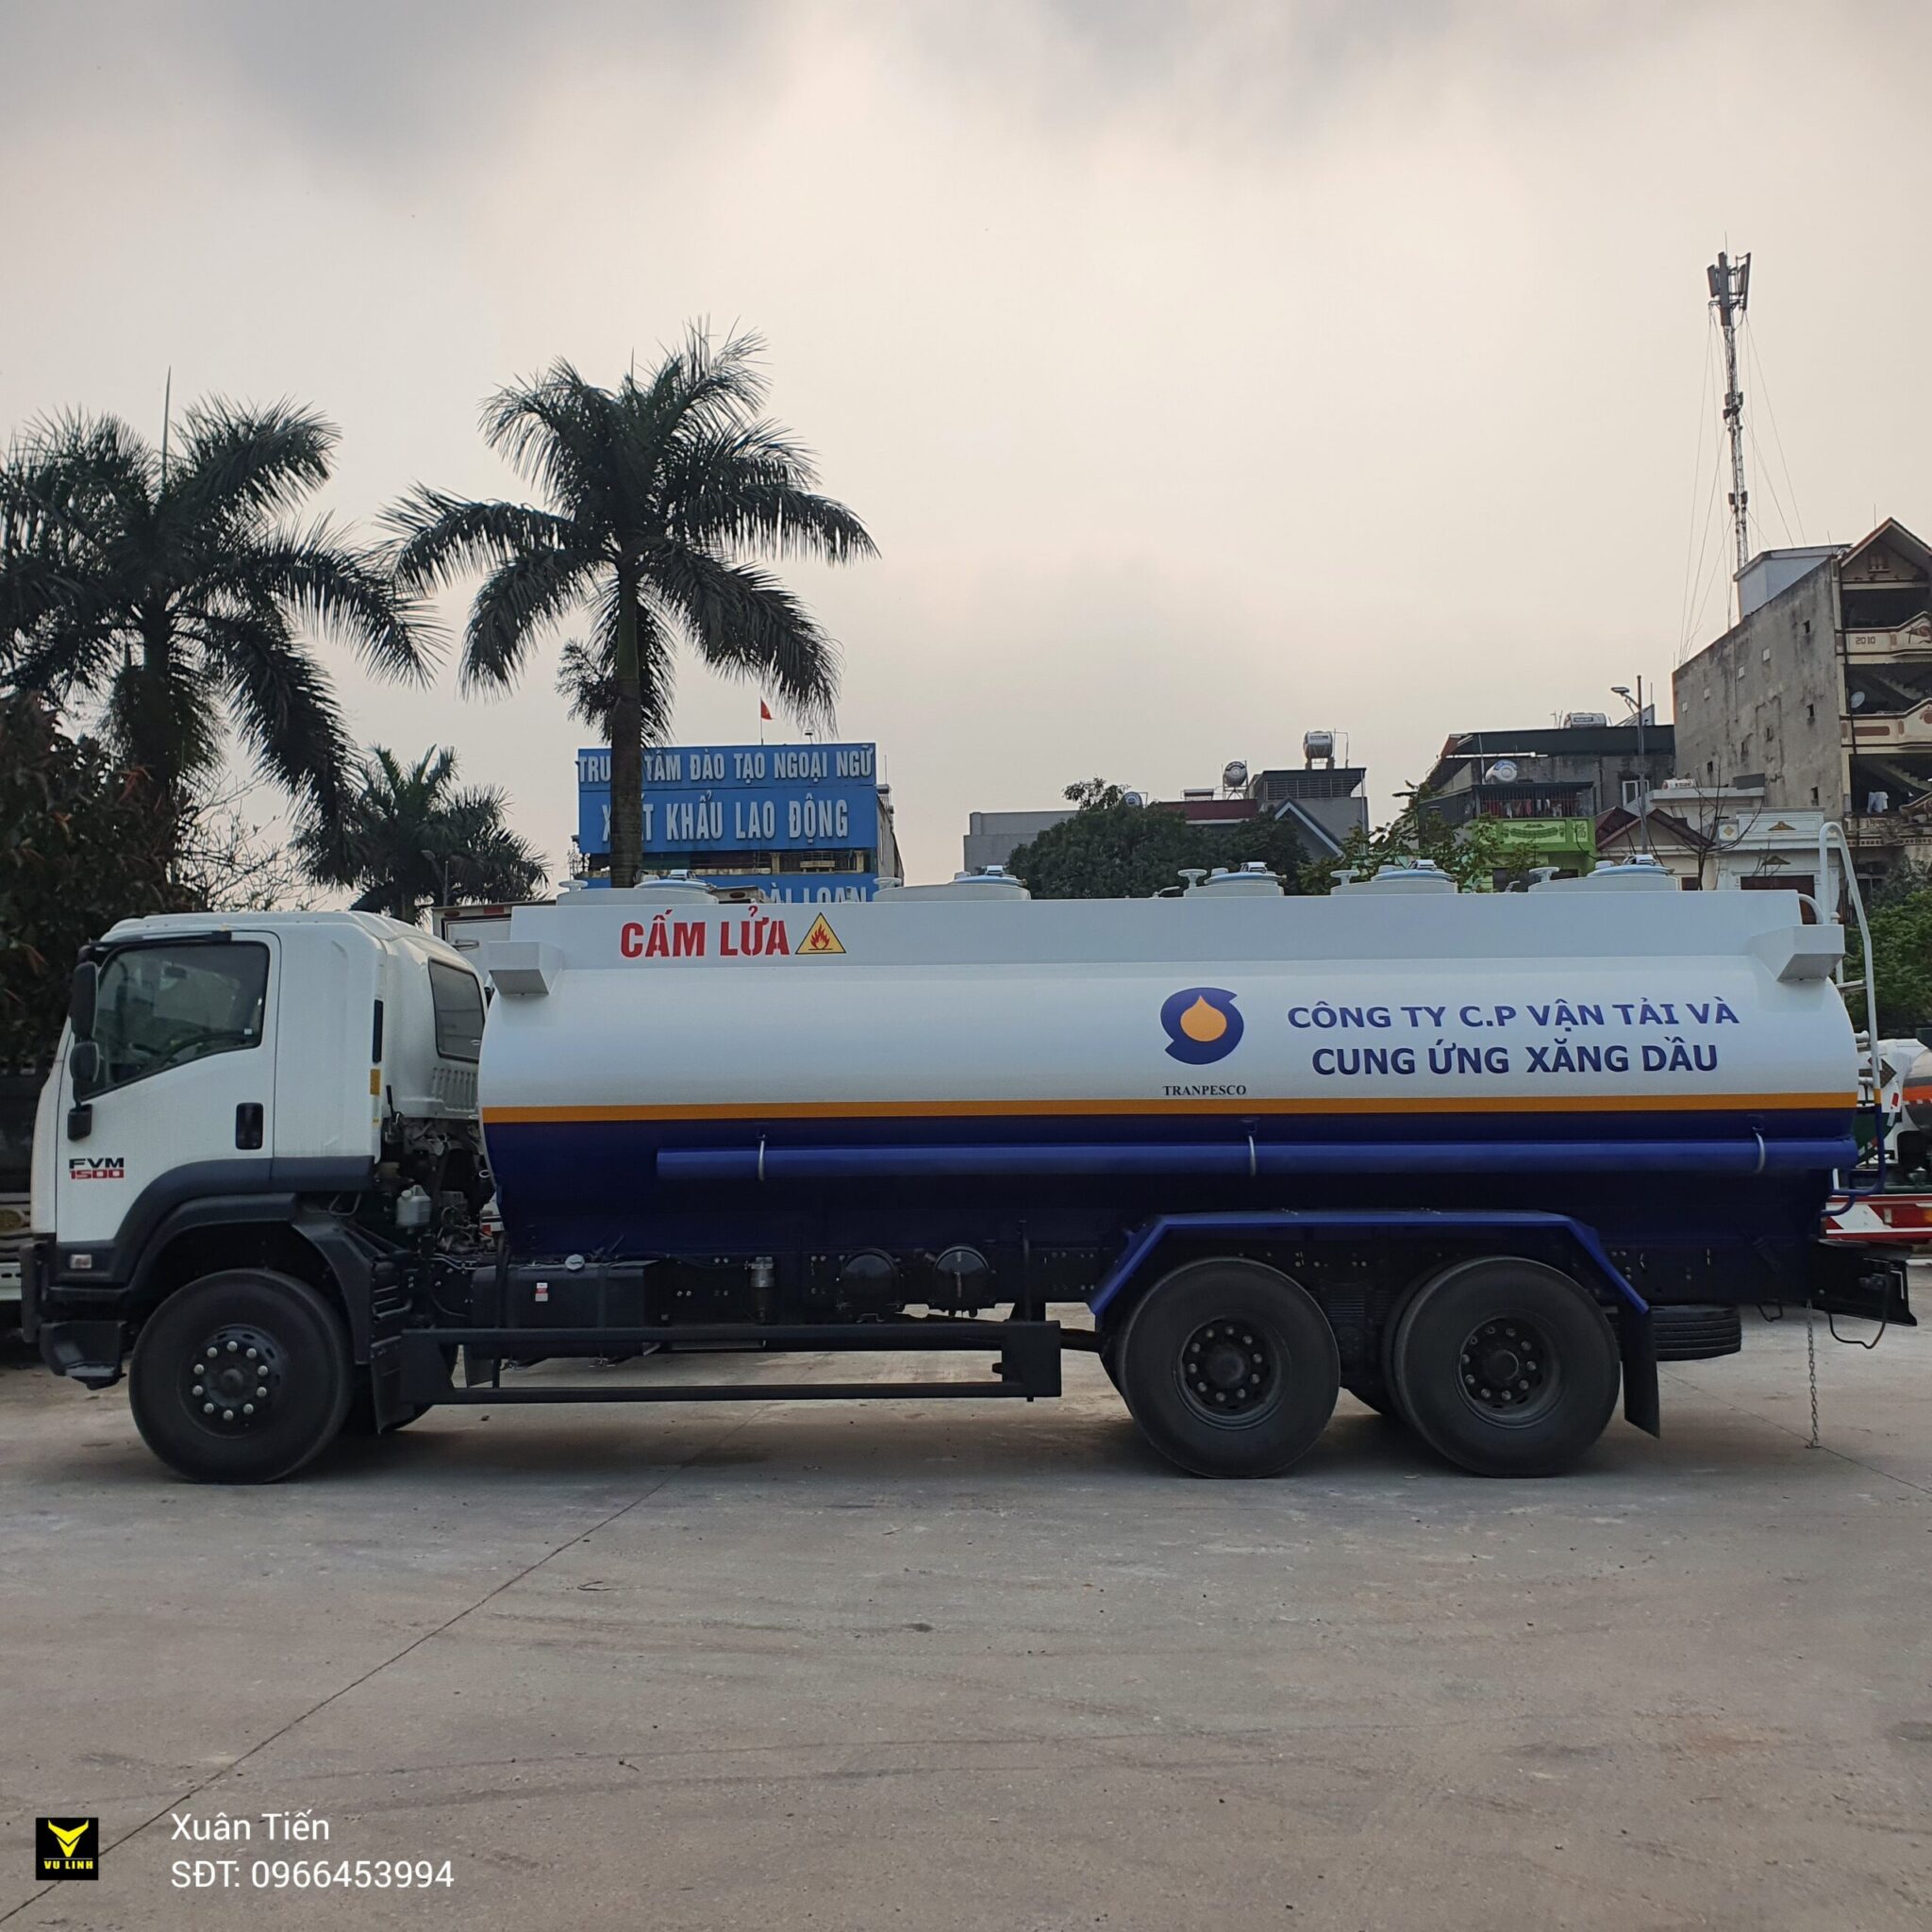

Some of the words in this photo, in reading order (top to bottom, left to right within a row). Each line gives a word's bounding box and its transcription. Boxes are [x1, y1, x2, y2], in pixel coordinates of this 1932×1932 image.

[1856, 636, 1876, 645] 2010
[578, 756, 611, 783] TRU
[690, 749, 725, 781] ĐÀO
[734, 752, 766, 784] TẠO
[774, 751, 828, 783] NGOẠI
[837, 744, 874, 777] NGỮ
[602, 793, 655, 841] XT
[666, 790, 724, 841] KHẨU
[735, 800, 776, 840] LAO
[789, 791, 849, 844] ĐỘNG
[620, 908, 706, 959] CẤM
[719, 906, 791, 957] LỬA
[1288, 1000, 1392, 1029] CÔNG
[1400, 1006, 1447, 1028] TY
[1458, 1005, 1517, 1027] C.P
[1526, 998, 1605, 1032] VẬN
[1611, 996, 1680, 1026] TẢI
[1685, 995, 1740, 1024] VÀ
[1312, 1047, 1416, 1075] CUNG
[1427, 1038, 1509, 1074] ỨNG
[1524, 1037, 1629, 1074] XĂNG
[1641, 1036, 1718, 1072] DẦU
[1162, 1084, 1247, 1096] TRANPESCO
[69, 1158, 125, 1169] FVM
[69, 1169, 125, 1179] 1500
